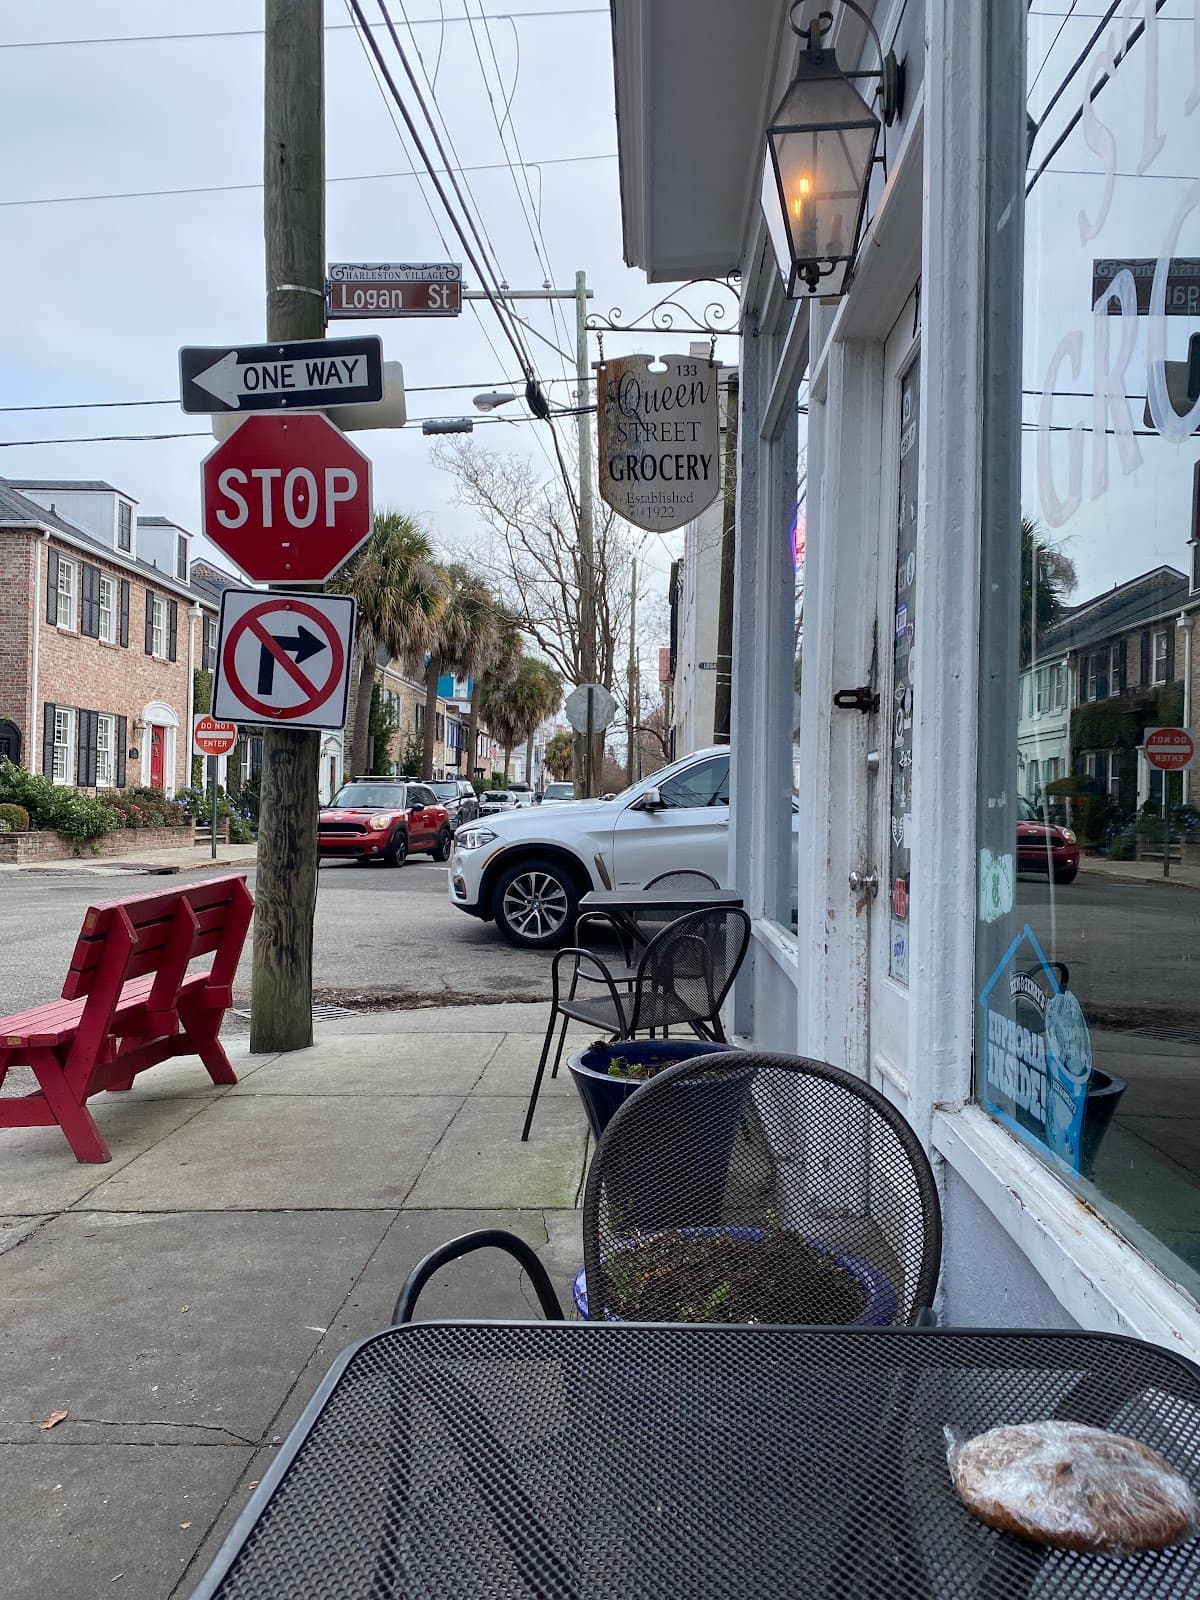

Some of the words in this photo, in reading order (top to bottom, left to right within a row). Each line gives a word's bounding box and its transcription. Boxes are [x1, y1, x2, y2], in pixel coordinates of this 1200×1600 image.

[346, 271, 401, 280] HARLESTON
[405, 271, 445, 280] VILLAGE
[341, 284, 403, 309] Logan
[427, 283, 450, 309] St
[243, 364, 296, 390] ONE
[305, 358, 359, 386] WAY
[676, 364, 698, 377] 133
[608, 371, 710, 432] Queen
[617, 421, 702, 442] STREET
[609, 454, 712, 482] GROCERY
[215, 466, 358, 529] STOP
[626, 491, 694, 504] Established
[648, 507, 675, 519] 1922
[988, 1008, 1047, 1074] EUPHORIA
[988, 1042, 1047, 1127] INSIDE!
